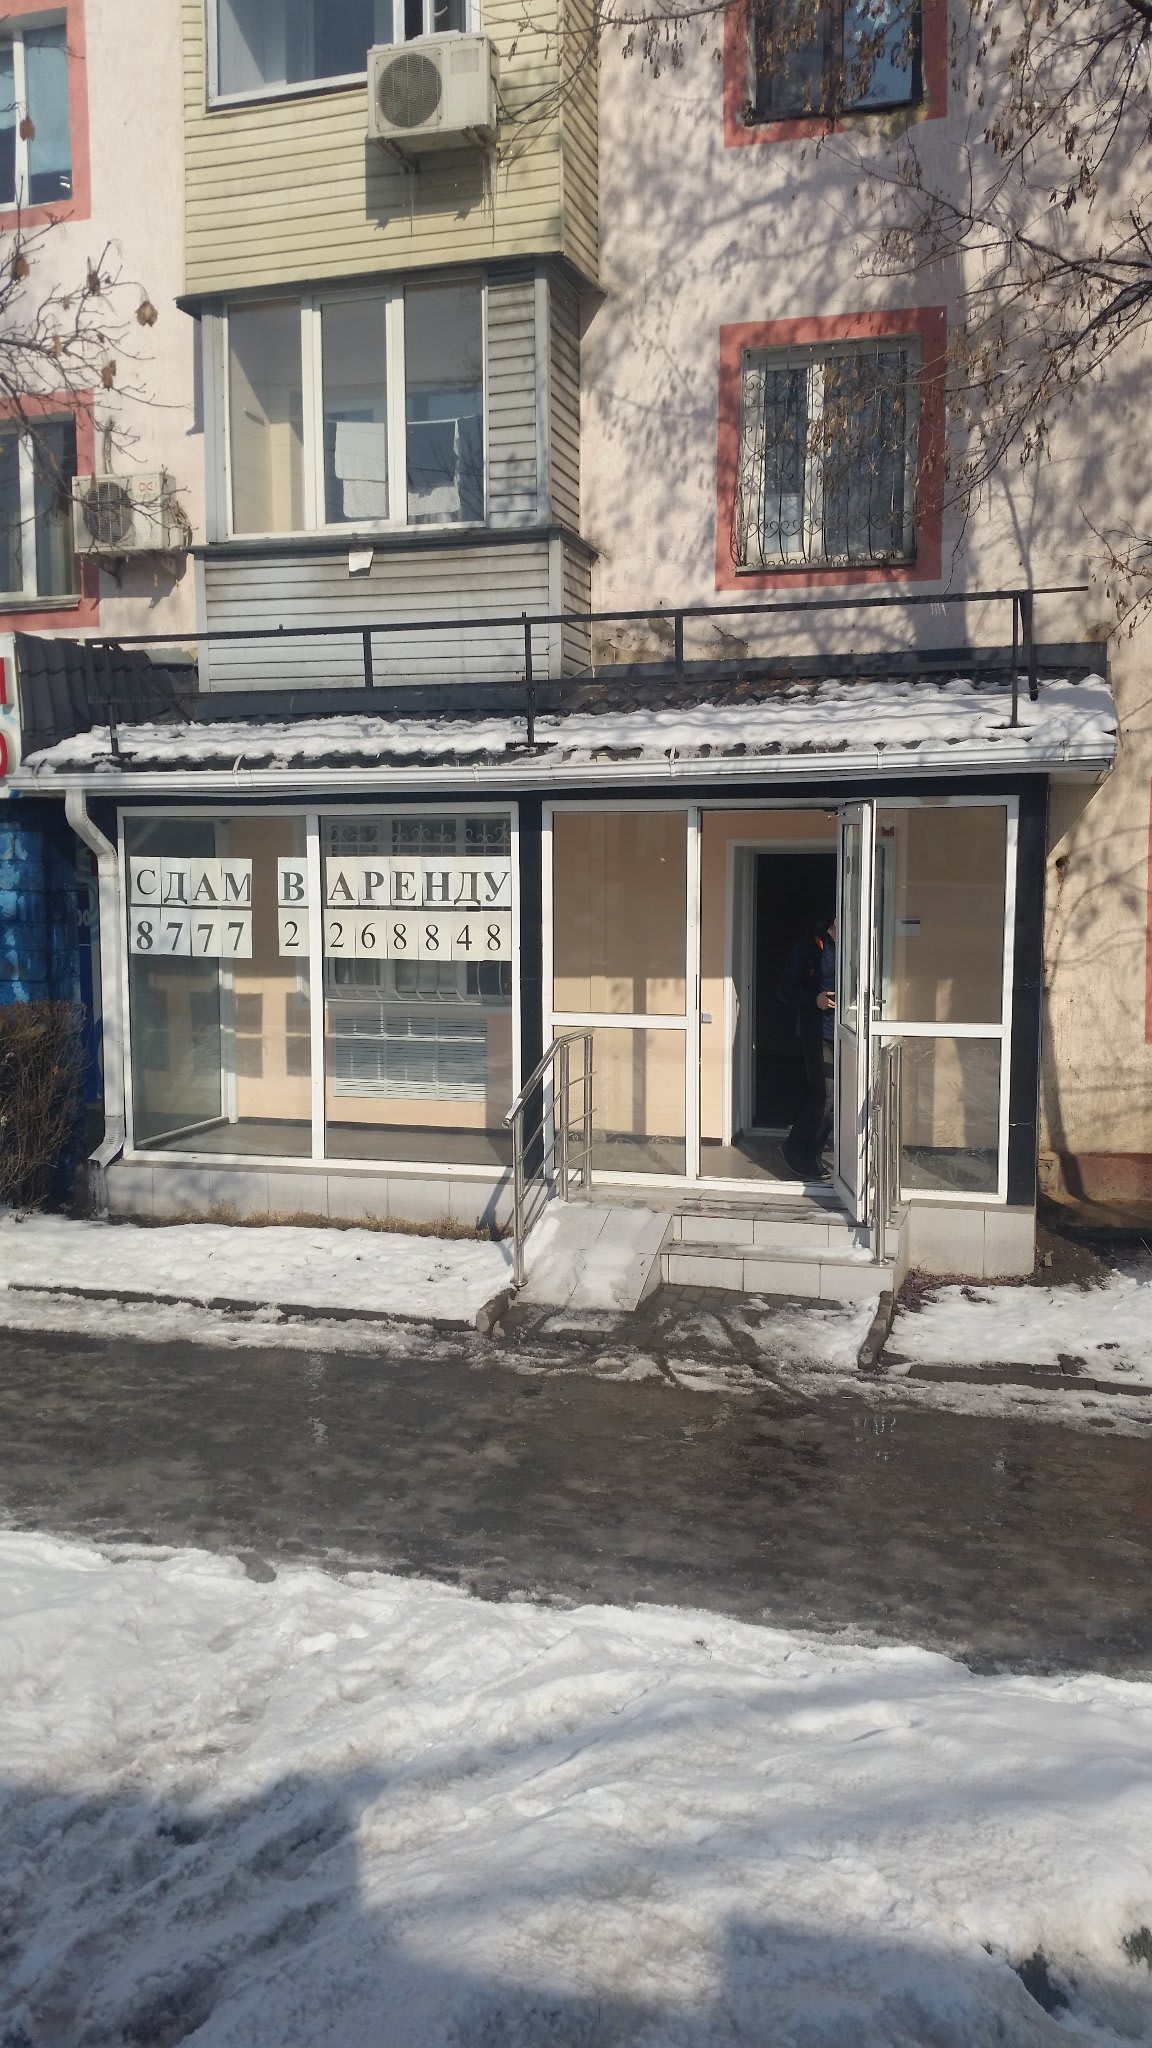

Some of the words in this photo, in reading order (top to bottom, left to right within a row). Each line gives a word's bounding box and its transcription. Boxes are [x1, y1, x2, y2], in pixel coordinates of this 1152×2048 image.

[136, 870, 251, 904] СДАМ
[281, 872, 305, 901] В
[328, 871, 510, 905] АРЕНДУ
[136, 920, 245, 952] 8777
